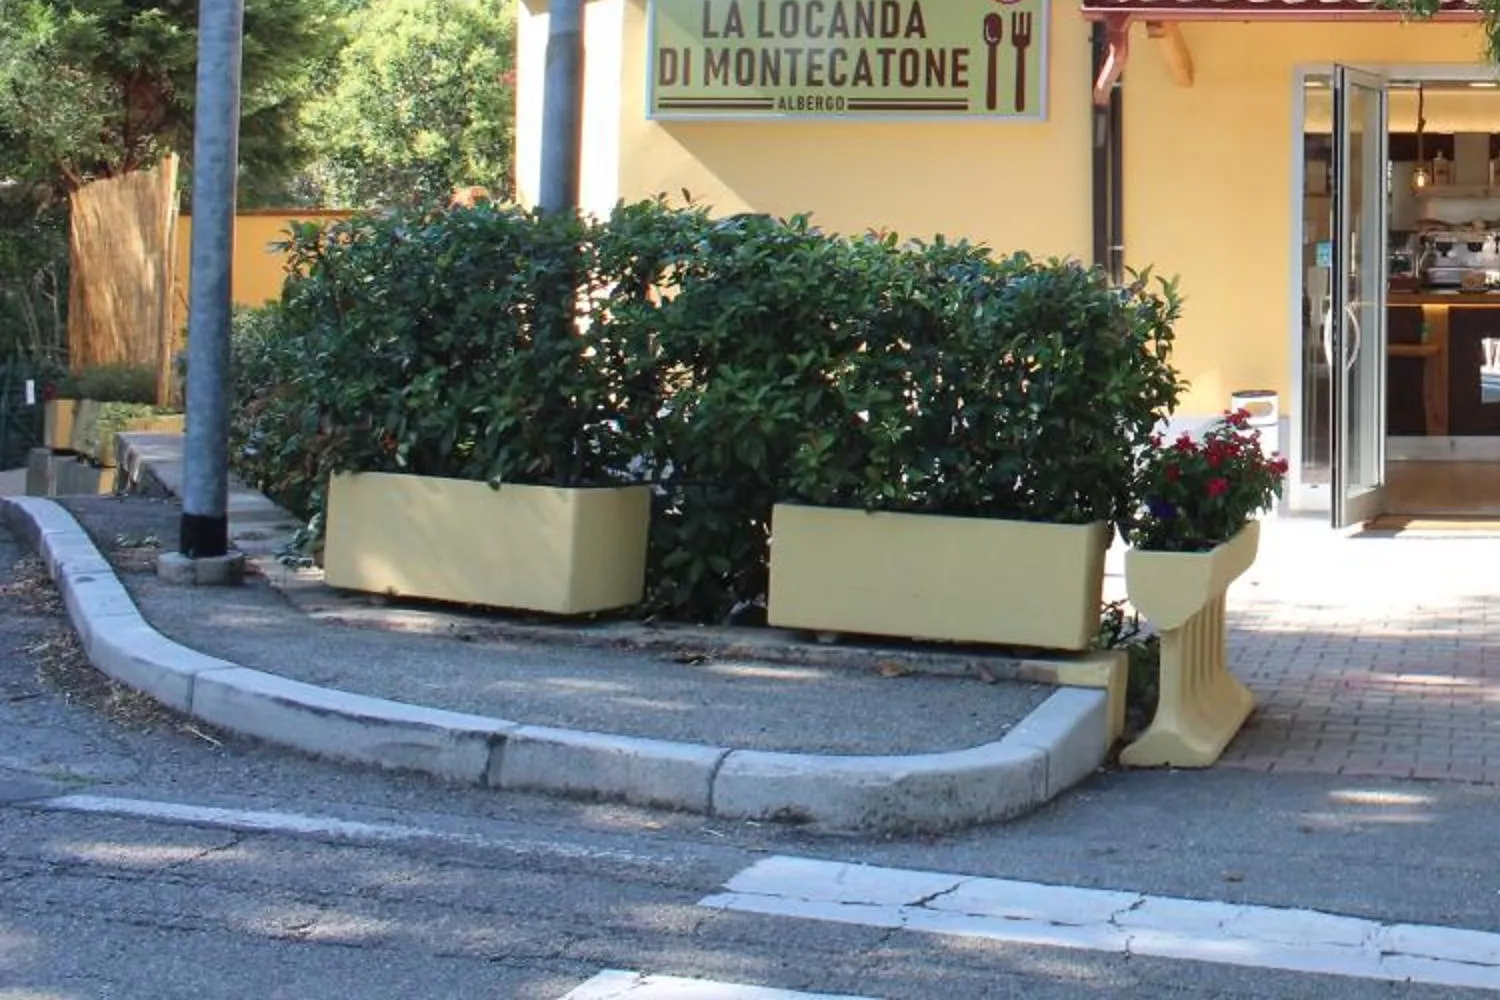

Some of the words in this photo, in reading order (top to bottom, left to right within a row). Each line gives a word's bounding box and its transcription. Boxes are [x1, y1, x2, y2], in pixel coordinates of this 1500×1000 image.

[702, 0, 745, 39] LA
[757, 0, 927, 39] LOCANDA
[658, 47, 691, 87] DI
[703, 47, 970, 89] MONTECATONE
[777, 96, 846, 112] ALBERGO
